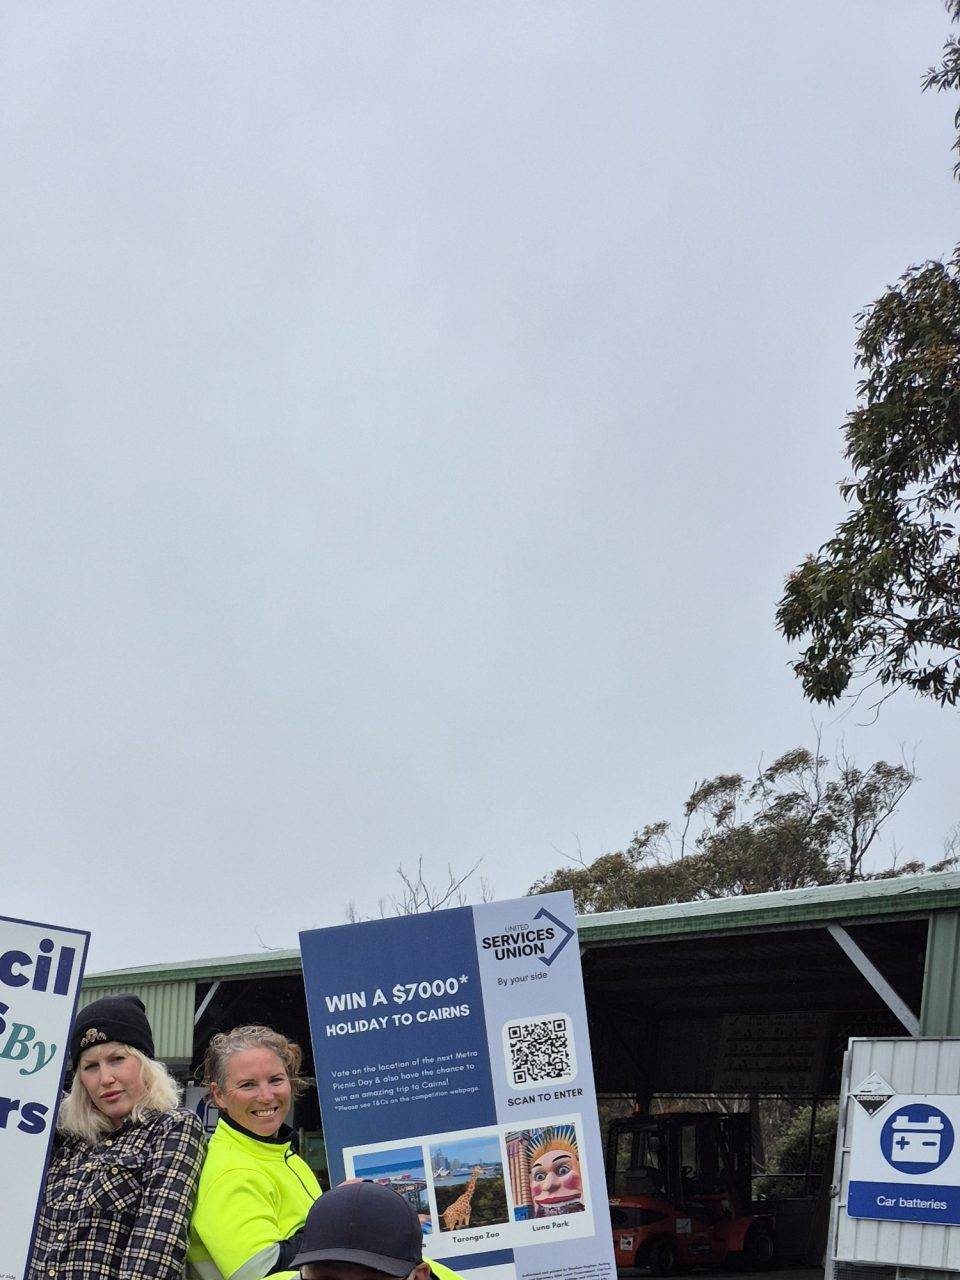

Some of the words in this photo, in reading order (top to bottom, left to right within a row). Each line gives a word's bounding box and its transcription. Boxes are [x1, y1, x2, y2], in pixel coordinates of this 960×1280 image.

[504, 923, 530, 933] UNITED
[481, 927, 555, 950] SERVICES
[494, 942, 545, 961] UNION
[497, 976, 508, 987] By
[509, 974, 529, 986] your
[530, 971, 548, 981] side
[324, 991, 367, 1013] WIN
[372, 988, 388, 1007] A
[326, 1016, 389, 1037] HOLIDAY
[392, 1013, 413, 1027] TO
[416, 1004, 470, 1023] CAIRNS
[331, 1069, 351, 1078] Vote
[363, 1065, 376, 1073] the
[378, 1060, 410, 1072] location
[411, 1058, 420, 1067] of
[422, 1056, 435, 1064] the
[436, 1053, 454, 1062] next
[455, 1050, 478, 1059] Metro
[332, 1081, 356, 1090] Picnic
[358, 1078, 373, 1087] Day
[383, 1074, 399, 1083] also
[401, 1070, 420, 1080] have
[421, 1068, 434, 1077] the
[436, 1064, 465, 1075] chance
[466, 1063, 475, 1071] to
[334, 1095, 348, 1103] win
[361, 1087, 394, 1098] amazing
[396, 1085, 410, 1094] trip
[411, 1083, 420, 1091] to
[421, 1078, 449, 1089] Cairns!
[411, 1090, 449, 1102] competition
[507, 1095, 536, 1107] SCAN
[537, 1092, 552, 1102] TO
[553, 1088, 583, 1100] ENTER
[876, 1195, 897, 1207] Car
[899, 1196, 948, 1210] batteries
[532, 1223, 551, 1232] Luna
[552, 1220, 570, 1230] Park
[452, 1233, 484, 1244] Taronga
[485, 1231, 500, 1240] Zoo
